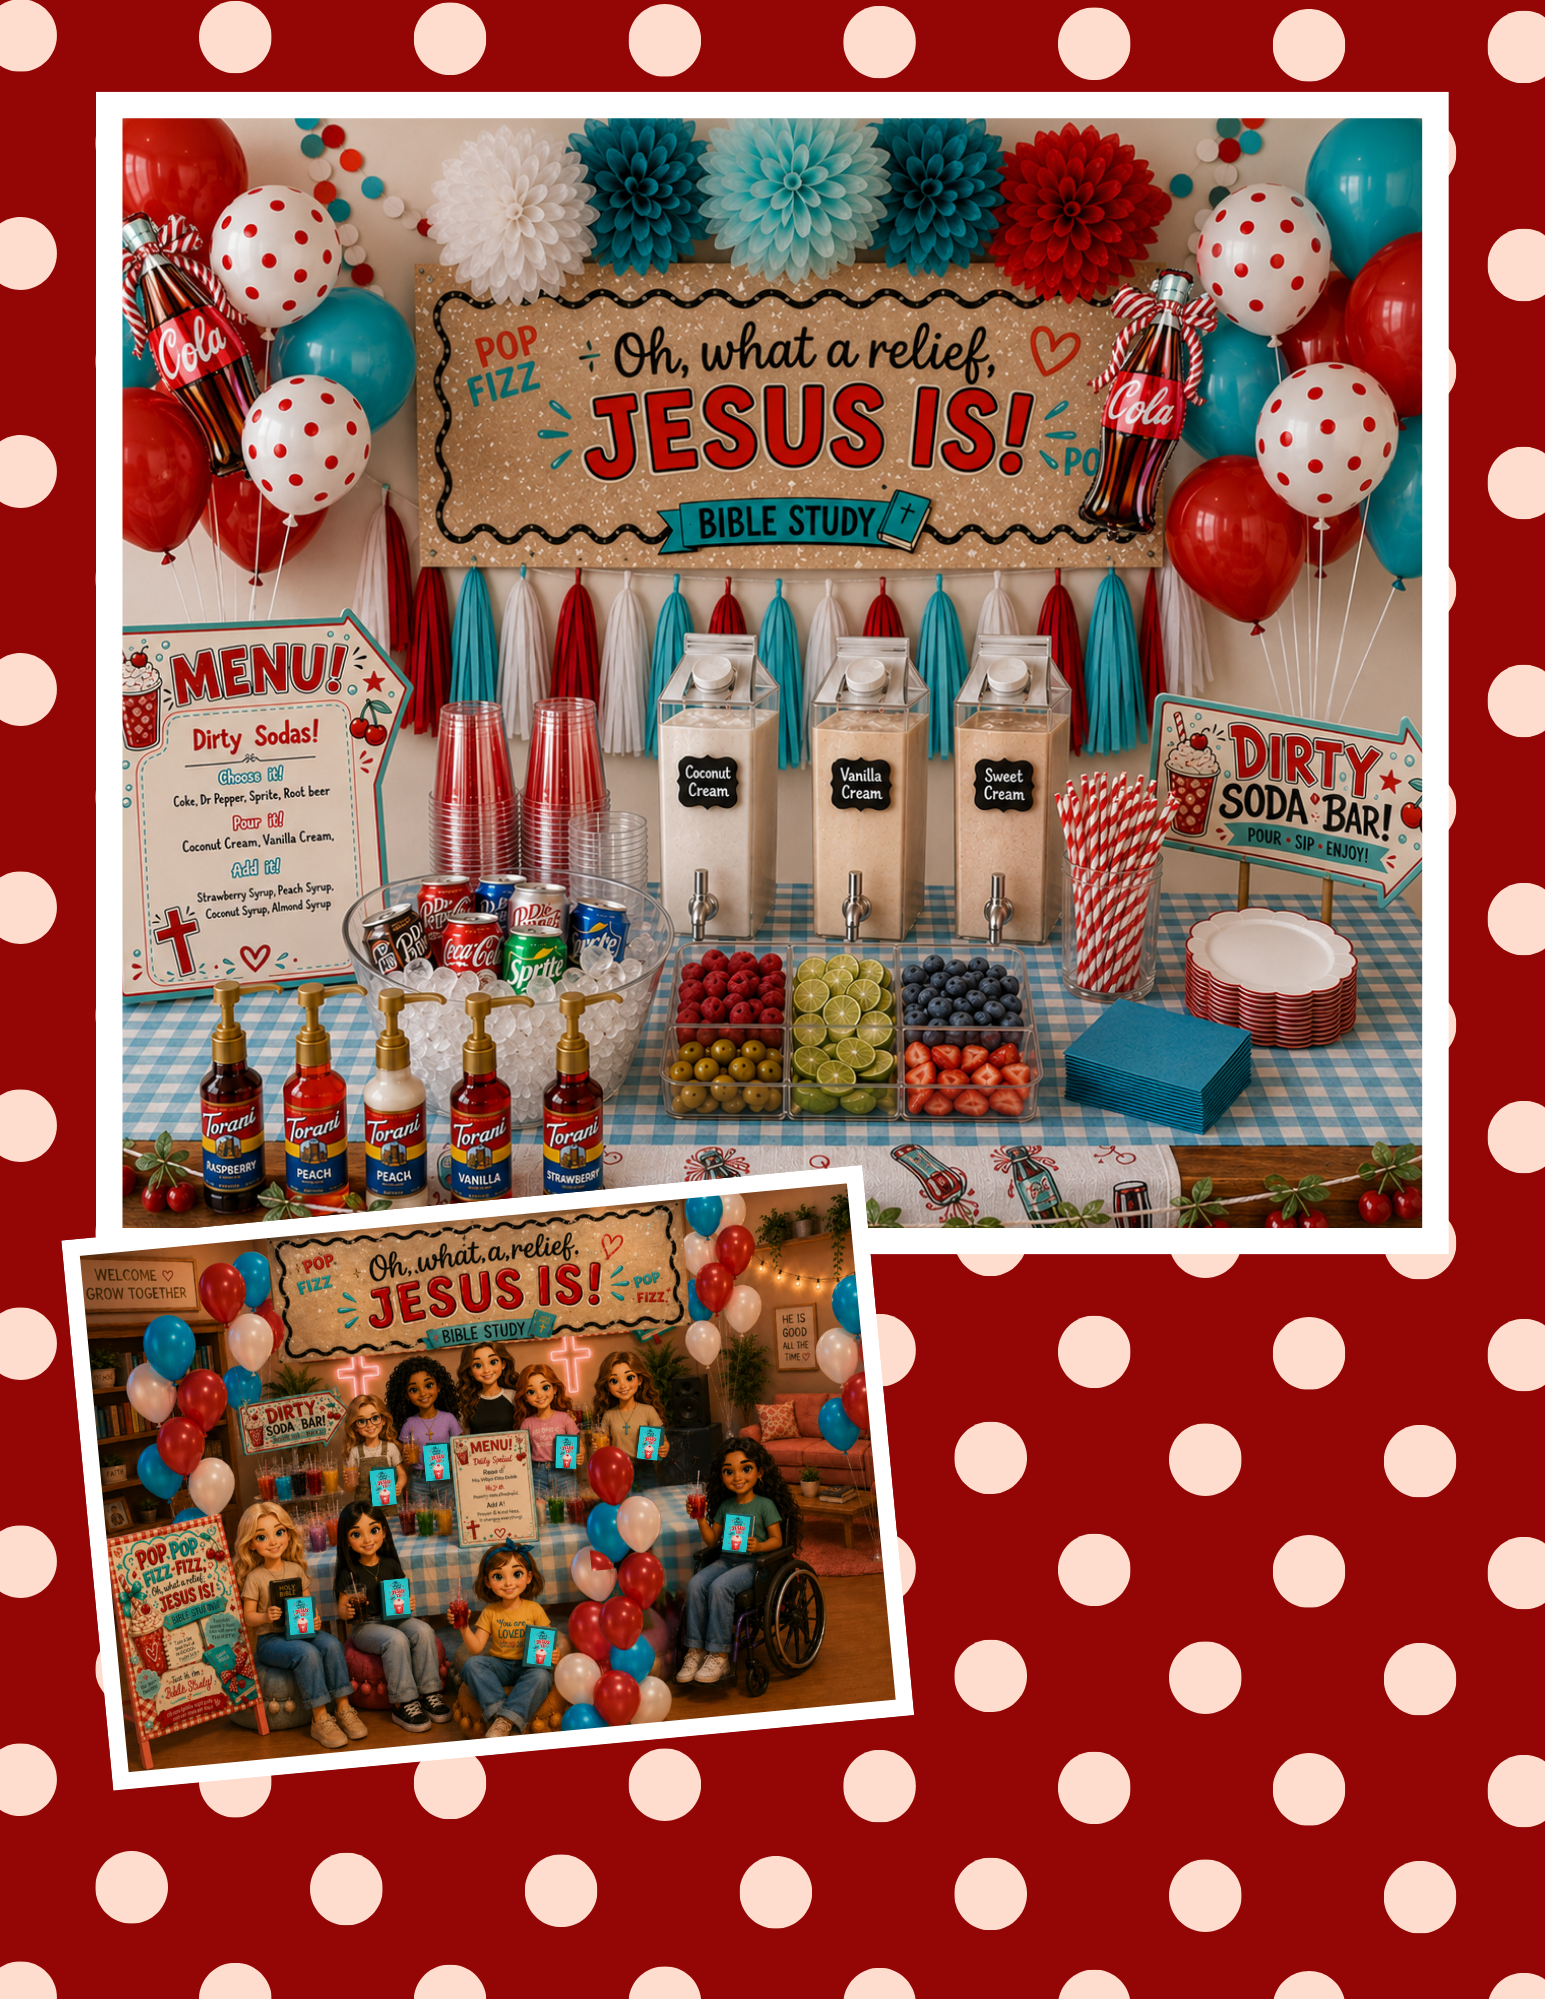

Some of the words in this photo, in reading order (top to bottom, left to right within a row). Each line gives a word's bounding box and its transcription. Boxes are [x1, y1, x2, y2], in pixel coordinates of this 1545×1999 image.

[158, 315, 227, 380] Cola
[474, 325, 537, 368] POP
[614, 326, 689, 378] Oh,
[702, 321, 817, 371] what
[827, 340, 859, 368] a
[869, 322, 995, 385] relief,
[467, 361, 540, 407] FIZZ
[1108, 380, 1174, 425] Cola
[583, 382, 886, 482] JESUS
[908, 384, 1034, 478] IS!
[1064, 447, 1100, 476] PO
[699, 506, 776, 539] BIBLE
[789, 504, 875, 537] STUDY
[170, 643, 349, 707] MENU!
[193, 728, 242, 755] Dirty
[255, 718, 319, 747] Sodas!
[1228, 722, 1383, 799] DIRTY
[267, 765, 284, 782] it!
[685, 764, 731, 780] Coconut
[840, 767, 882, 783] Vanilla
[985, 767, 1024, 784] Sweet
[173, 795, 198, 807] Coke,
[200, 794, 211, 805] Dr
[214, 793, 247, 807] Pepper,
[249, 790, 281, 804] Sprite,
[283, 786, 305, 799] Root
[308, 785, 330, 797] beer
[688, 781, 730, 798] Cream
[841, 785, 883, 800] Cream
[984, 786, 1026, 801] Cream
[232, 814, 262, 831] Pour
[267, 810, 284, 828] it!
[1219, 783, 1308, 825] SODA
[1322, 794, 1392, 842] BAR!
[182, 839, 221, 853] Coconut
[262, 832, 296, 846] Vanilla
[1247, 827, 1281, 845] POUR
[1295, 834, 1315, 851] SIP
[1326, 841, 1369, 863] ENJOY!
[231, 858, 259, 878] Add
[264, 857, 281, 875] it!
[197, 890, 246, 903] Strawberry
[248, 887, 276, 900] Syrup,
[278, 883, 303, 895] Peach
[205, 907, 240, 919] Coconut
[242, 904, 270, 918] Syrup,
[271, 900, 303, 913] Almond
[305, 898, 331, 911] Syrup
[203, 1107, 256, 1137] Torani
[286, 1110, 340, 1142] Torani
[367, 1113, 420, 1145] Torani
[453, 1117, 507, 1148] Torani
[546, 1116, 599, 1148] Torani
[206, 1160, 257, 1175] RASPBERRY
[297, 1168, 332, 1180] PEACH
[376, 1170, 412, 1182] PEACH
[546, 1168, 600, 1184] STRAWBERRY
[458, 1172, 501, 1185] VANILLA
[94, 1268, 157, 1281] WELCOME
[302, 1254, 334, 1274] POP
[297, 1275, 333, 1295] FIZZ
[633, 1271, 660, 1288] POP
[86, 1287, 124, 1300] GROW
[128, 1287, 187, 1299] TOGETHER
[368, 1267, 524, 1330] JESUS
[538, 1261, 601, 1306] IS!
[782, 1314, 794, 1324] HE
[797, 1313, 806, 1323] IS
[442, 1326, 478, 1344] BIBLE
[484, 1321, 525, 1339] STUDY
[782, 1327, 807, 1338] GOOD
[783, 1341, 794, 1350] ALL
[796, 1340, 809, 1349] THE
[784, 1352, 801, 1361] TIME
[265, 1400, 315, 1424] DIRTY
[266, 1422, 295, 1436] SODA
[301, 1415, 326, 1429] BAR!
[470, 1438, 512, 1454] MENU!
[106, 1468, 124, 1478] FAITH
[135, 1543, 167, 1570] POP
[168, 1537, 198, 1560] POP
[164, 1579, 180, 1592] what
[280, 1589, 297, 1598] BIBLE
[159, 1587, 197, 1613] JESUS
[198, 1582, 215, 1600] IS!
[171, 1611, 190, 1625] BIBLE
[498, 1628, 525, 1638] LOVED
